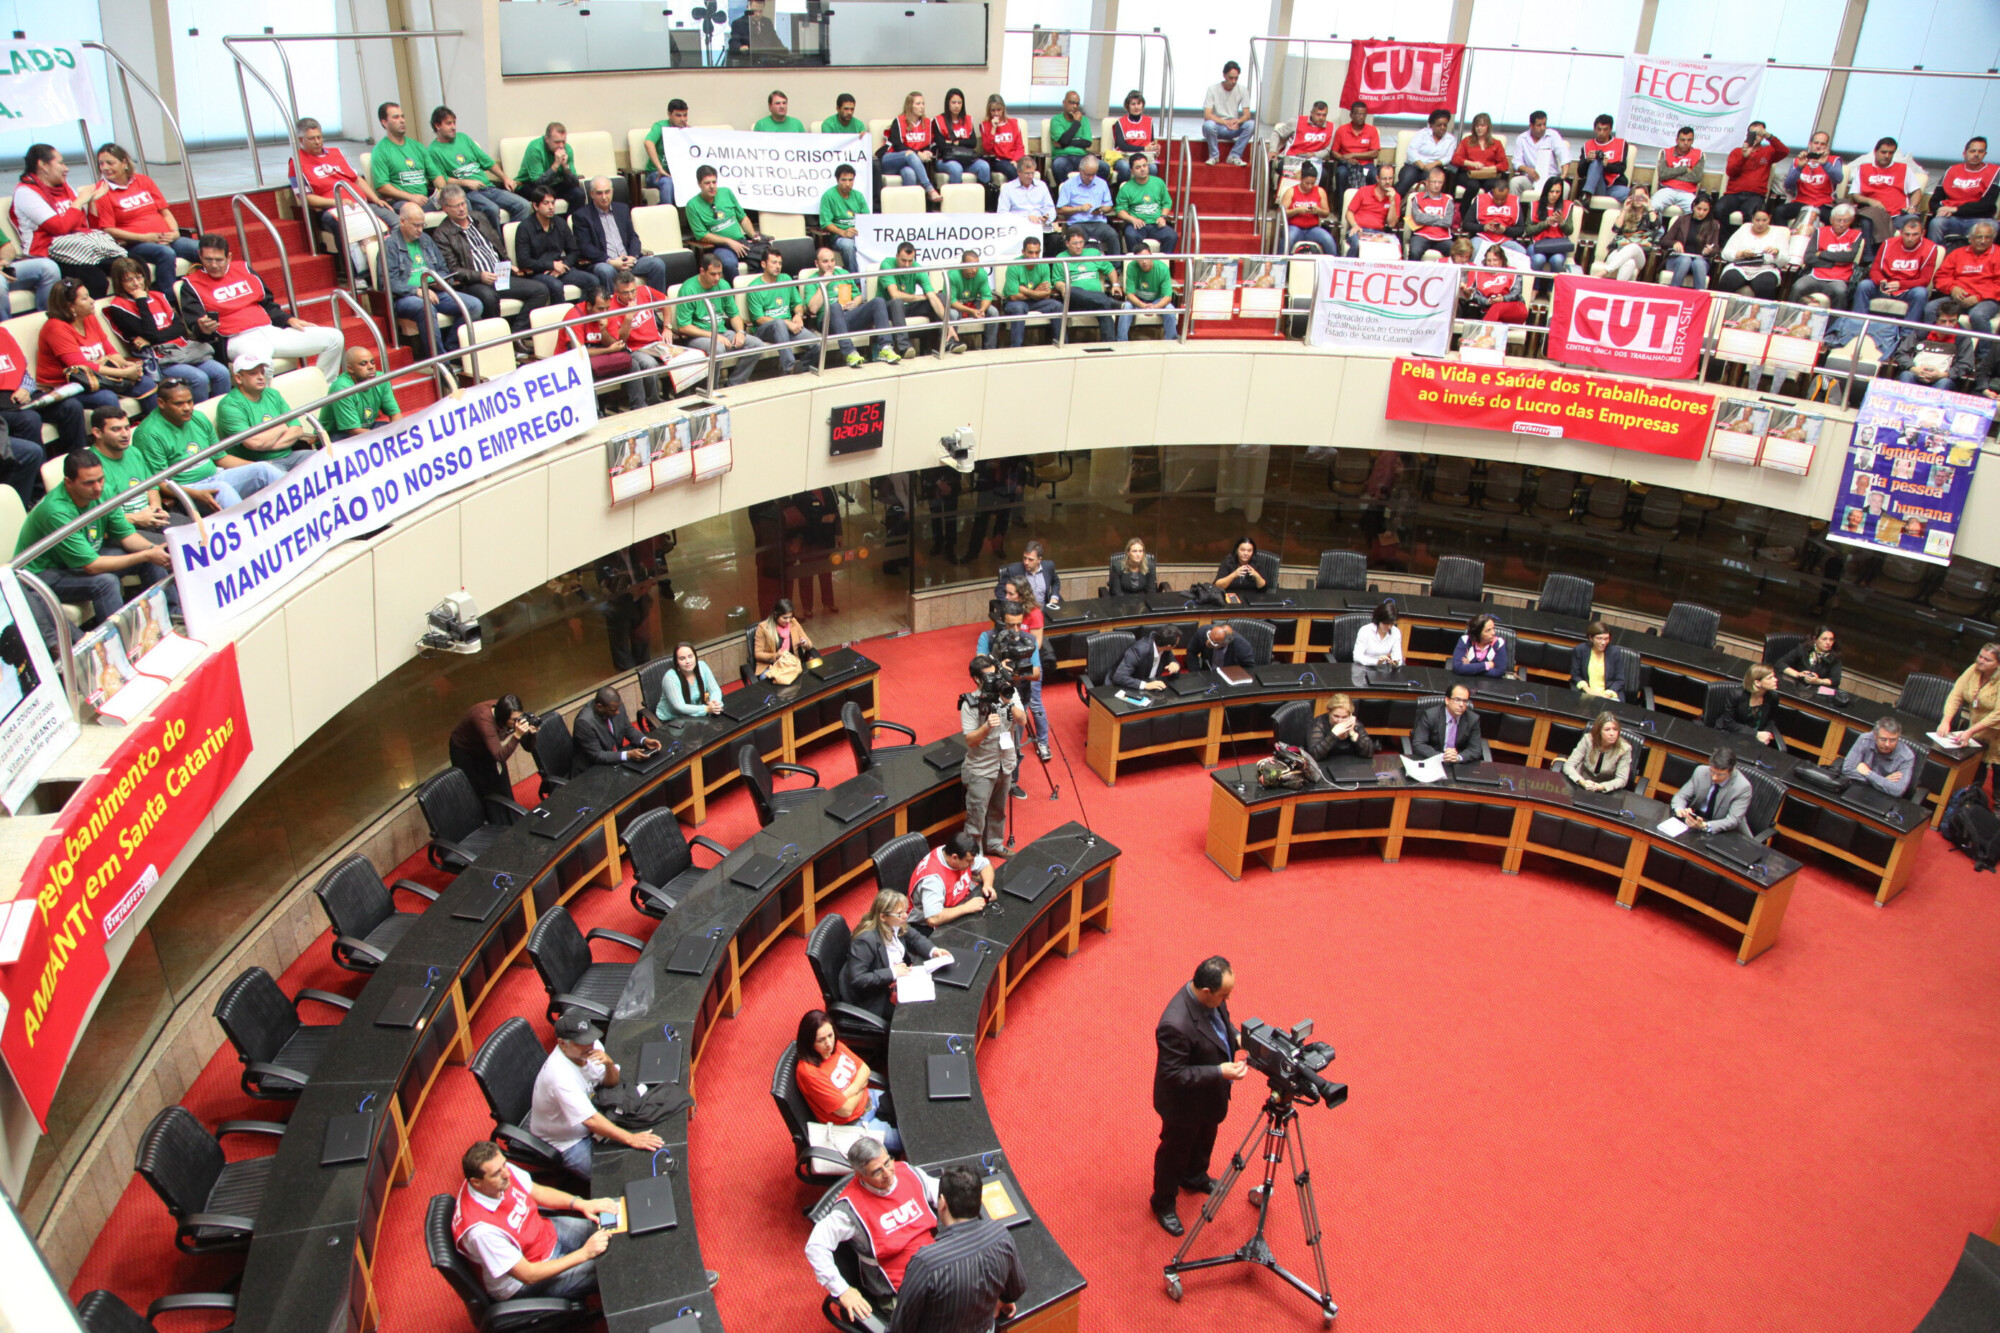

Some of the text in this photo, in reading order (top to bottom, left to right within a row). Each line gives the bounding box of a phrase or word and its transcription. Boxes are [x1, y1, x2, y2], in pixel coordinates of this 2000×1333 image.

[1364, 48, 1442, 92] CUT
[1440, 48, 1454, 96] BRASIL
[1635, 65, 1747, 106] FECESC
[1359, 93, 1379, 101] CENTRAL
[689, 145, 868, 163] O AMIANTO CRISOTILA
[719, 165, 833, 180] CONTROLADO
[119, 192, 150, 210] CUT
[752, 184, 819, 198] SEGURO
[1892, 259, 1917, 269] CUT
[213, 282, 248, 301] CUT
[1329, 268, 1444, 308] FECESC
[1327, 319, 1375, 333] Trabalhadores
[1328, 310, 1379, 324] Federação dos
[1574, 296, 1679, 349] CUT
[1673, 302, 1696, 356] BRASIL
[1325, 327, 1348, 338] Estado
[1361, 331, 1381, 342] Santa
[1565, 343, 1682, 363] CENTRAL ÚNICA DOS TRABALHADORES
[1401, 361, 1436, 380] Pela
[1440, 365, 1476, 384] Vida
[1480, 373, 1491, 385] e
[1495, 371, 1546, 390] Saúde
[1550, 376, 1580, 394] dos
[1586, 381, 1708, 416] Trabalhadores
[1418, 389, 1680, 435] ao invés do Lucro das Empresas
[182, 366, 581, 572] NÓS TRABALHADORES LUTAMOS PELA
[1873, 442, 1946, 466] dignidade
[1870, 473, 1944, 499] da pessoa
[215, 405, 580, 608] MANUTENÇÃO DO NOSSO EMPREGO.
[1892, 500, 1953, 523] humana
[30, 716, 57, 746] AMIANTO
[36, 718, 186, 927] pelo banimento do
[85, 853, 122, 900] em
[118, 793, 168, 861] Santa
[165, 717, 235, 798] Catarina
[829, 1053, 855, 1090] CUT
[507, 1187, 528, 1230] CUT
[879, 1199, 920, 1231] CUT
